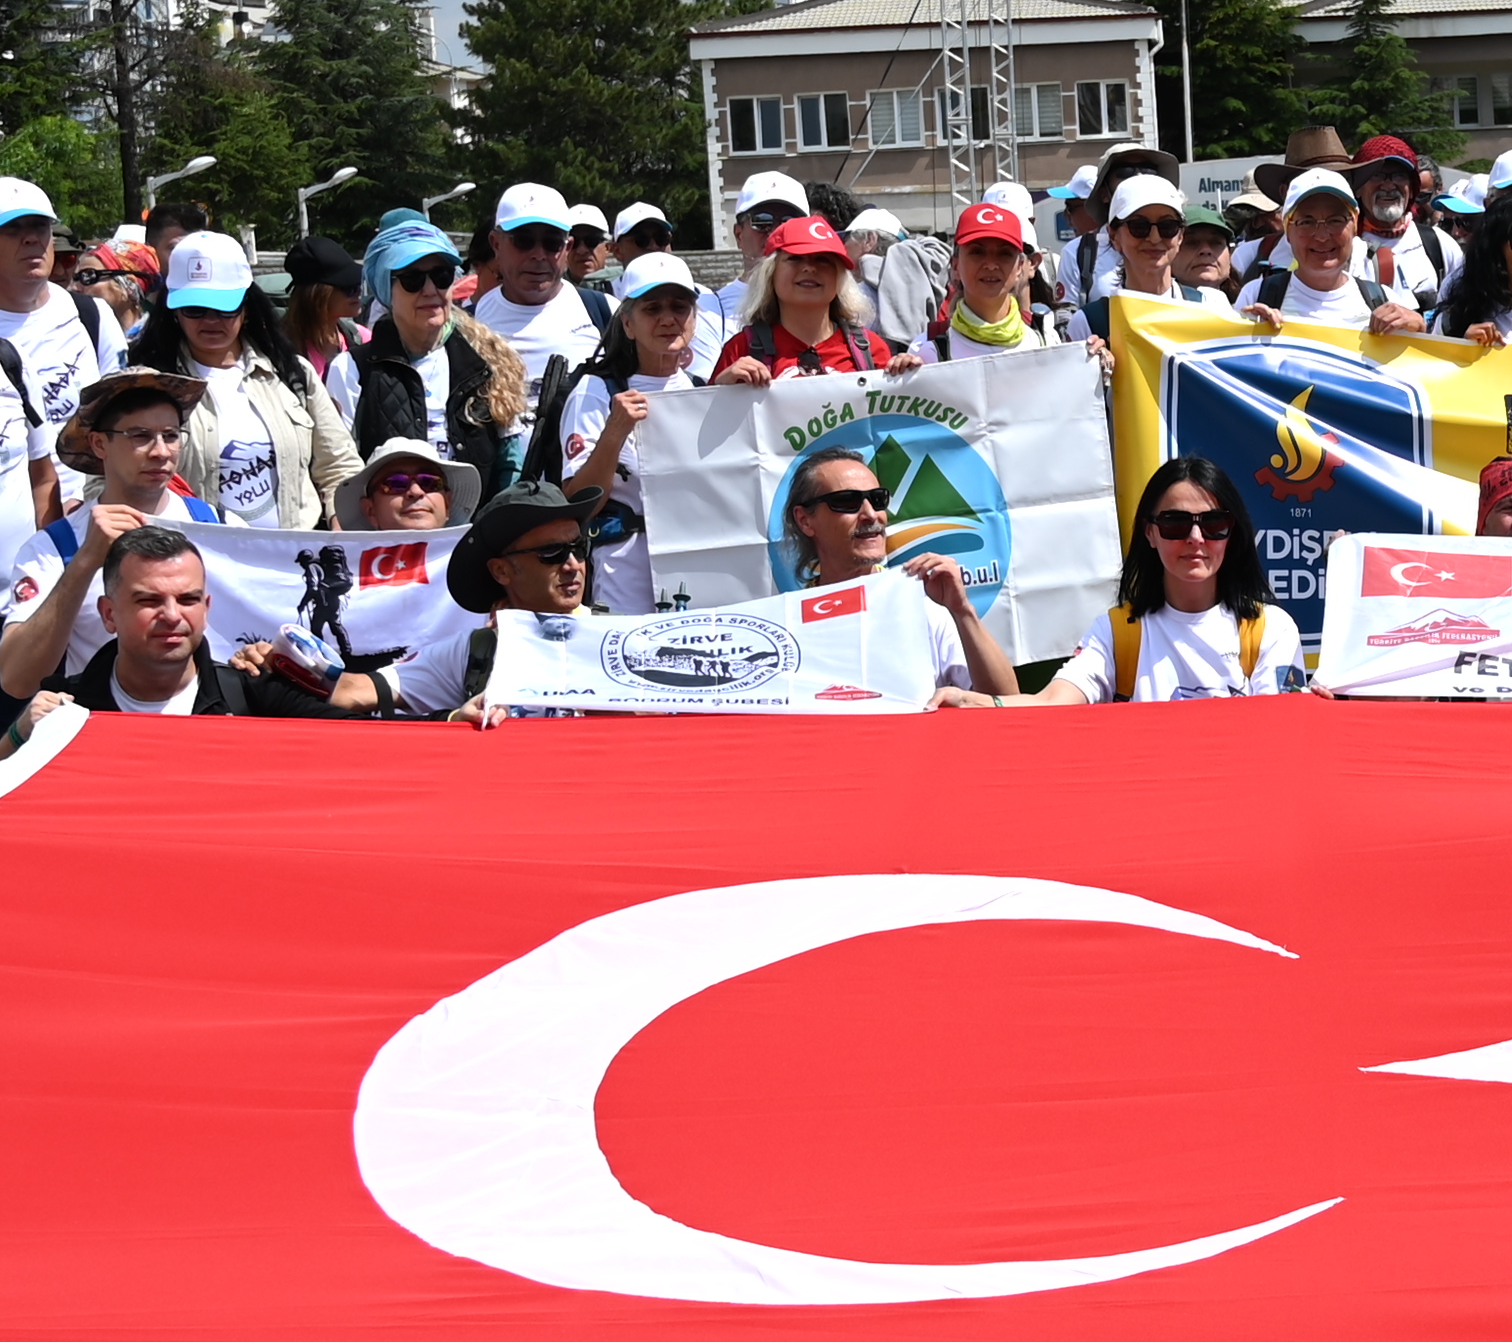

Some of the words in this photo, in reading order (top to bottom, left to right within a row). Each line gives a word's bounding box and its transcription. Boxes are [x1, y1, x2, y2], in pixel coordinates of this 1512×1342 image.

[784, 402, 855, 451] DOĞA
[865, 390, 969, 430] TUTKUSU
[1289, 508, 1313, 518] 1871
[960, 562, 1000, 586] b.u.l
[729, 617, 788, 643] SPORLARI
